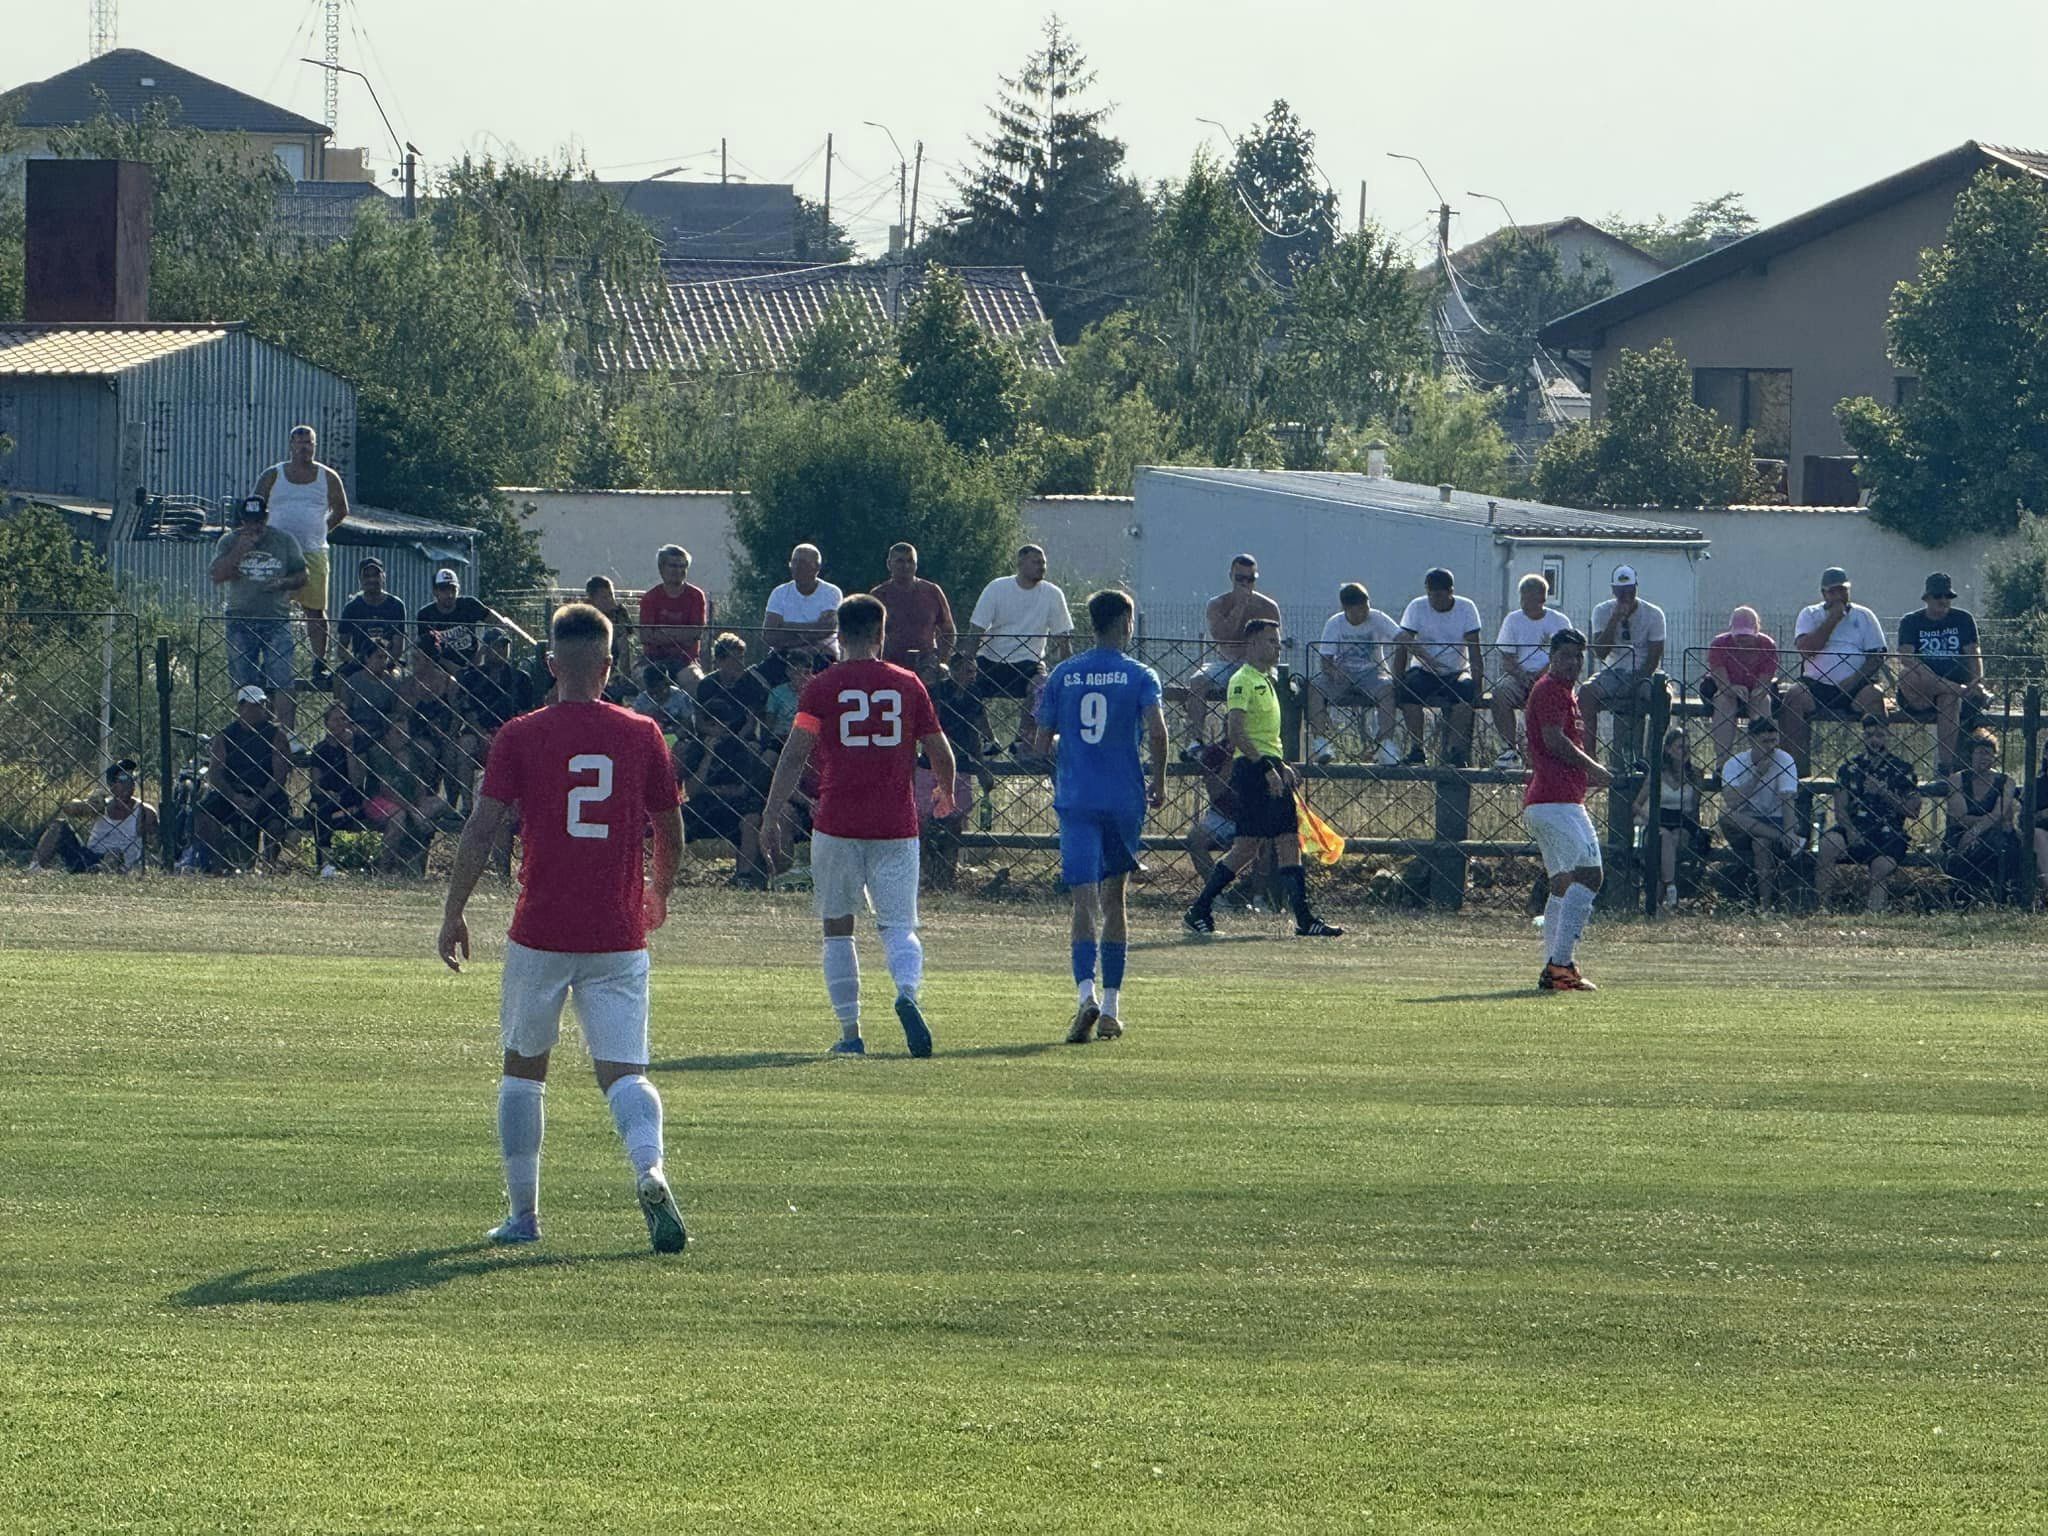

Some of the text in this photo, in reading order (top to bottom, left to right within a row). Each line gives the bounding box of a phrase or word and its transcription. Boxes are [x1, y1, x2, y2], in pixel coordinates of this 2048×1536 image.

[1063, 672, 1084, 687] C.S.
[838, 689, 902, 747] 23
[1080, 692, 1107, 744] 9
[567, 754, 613, 839] 2
